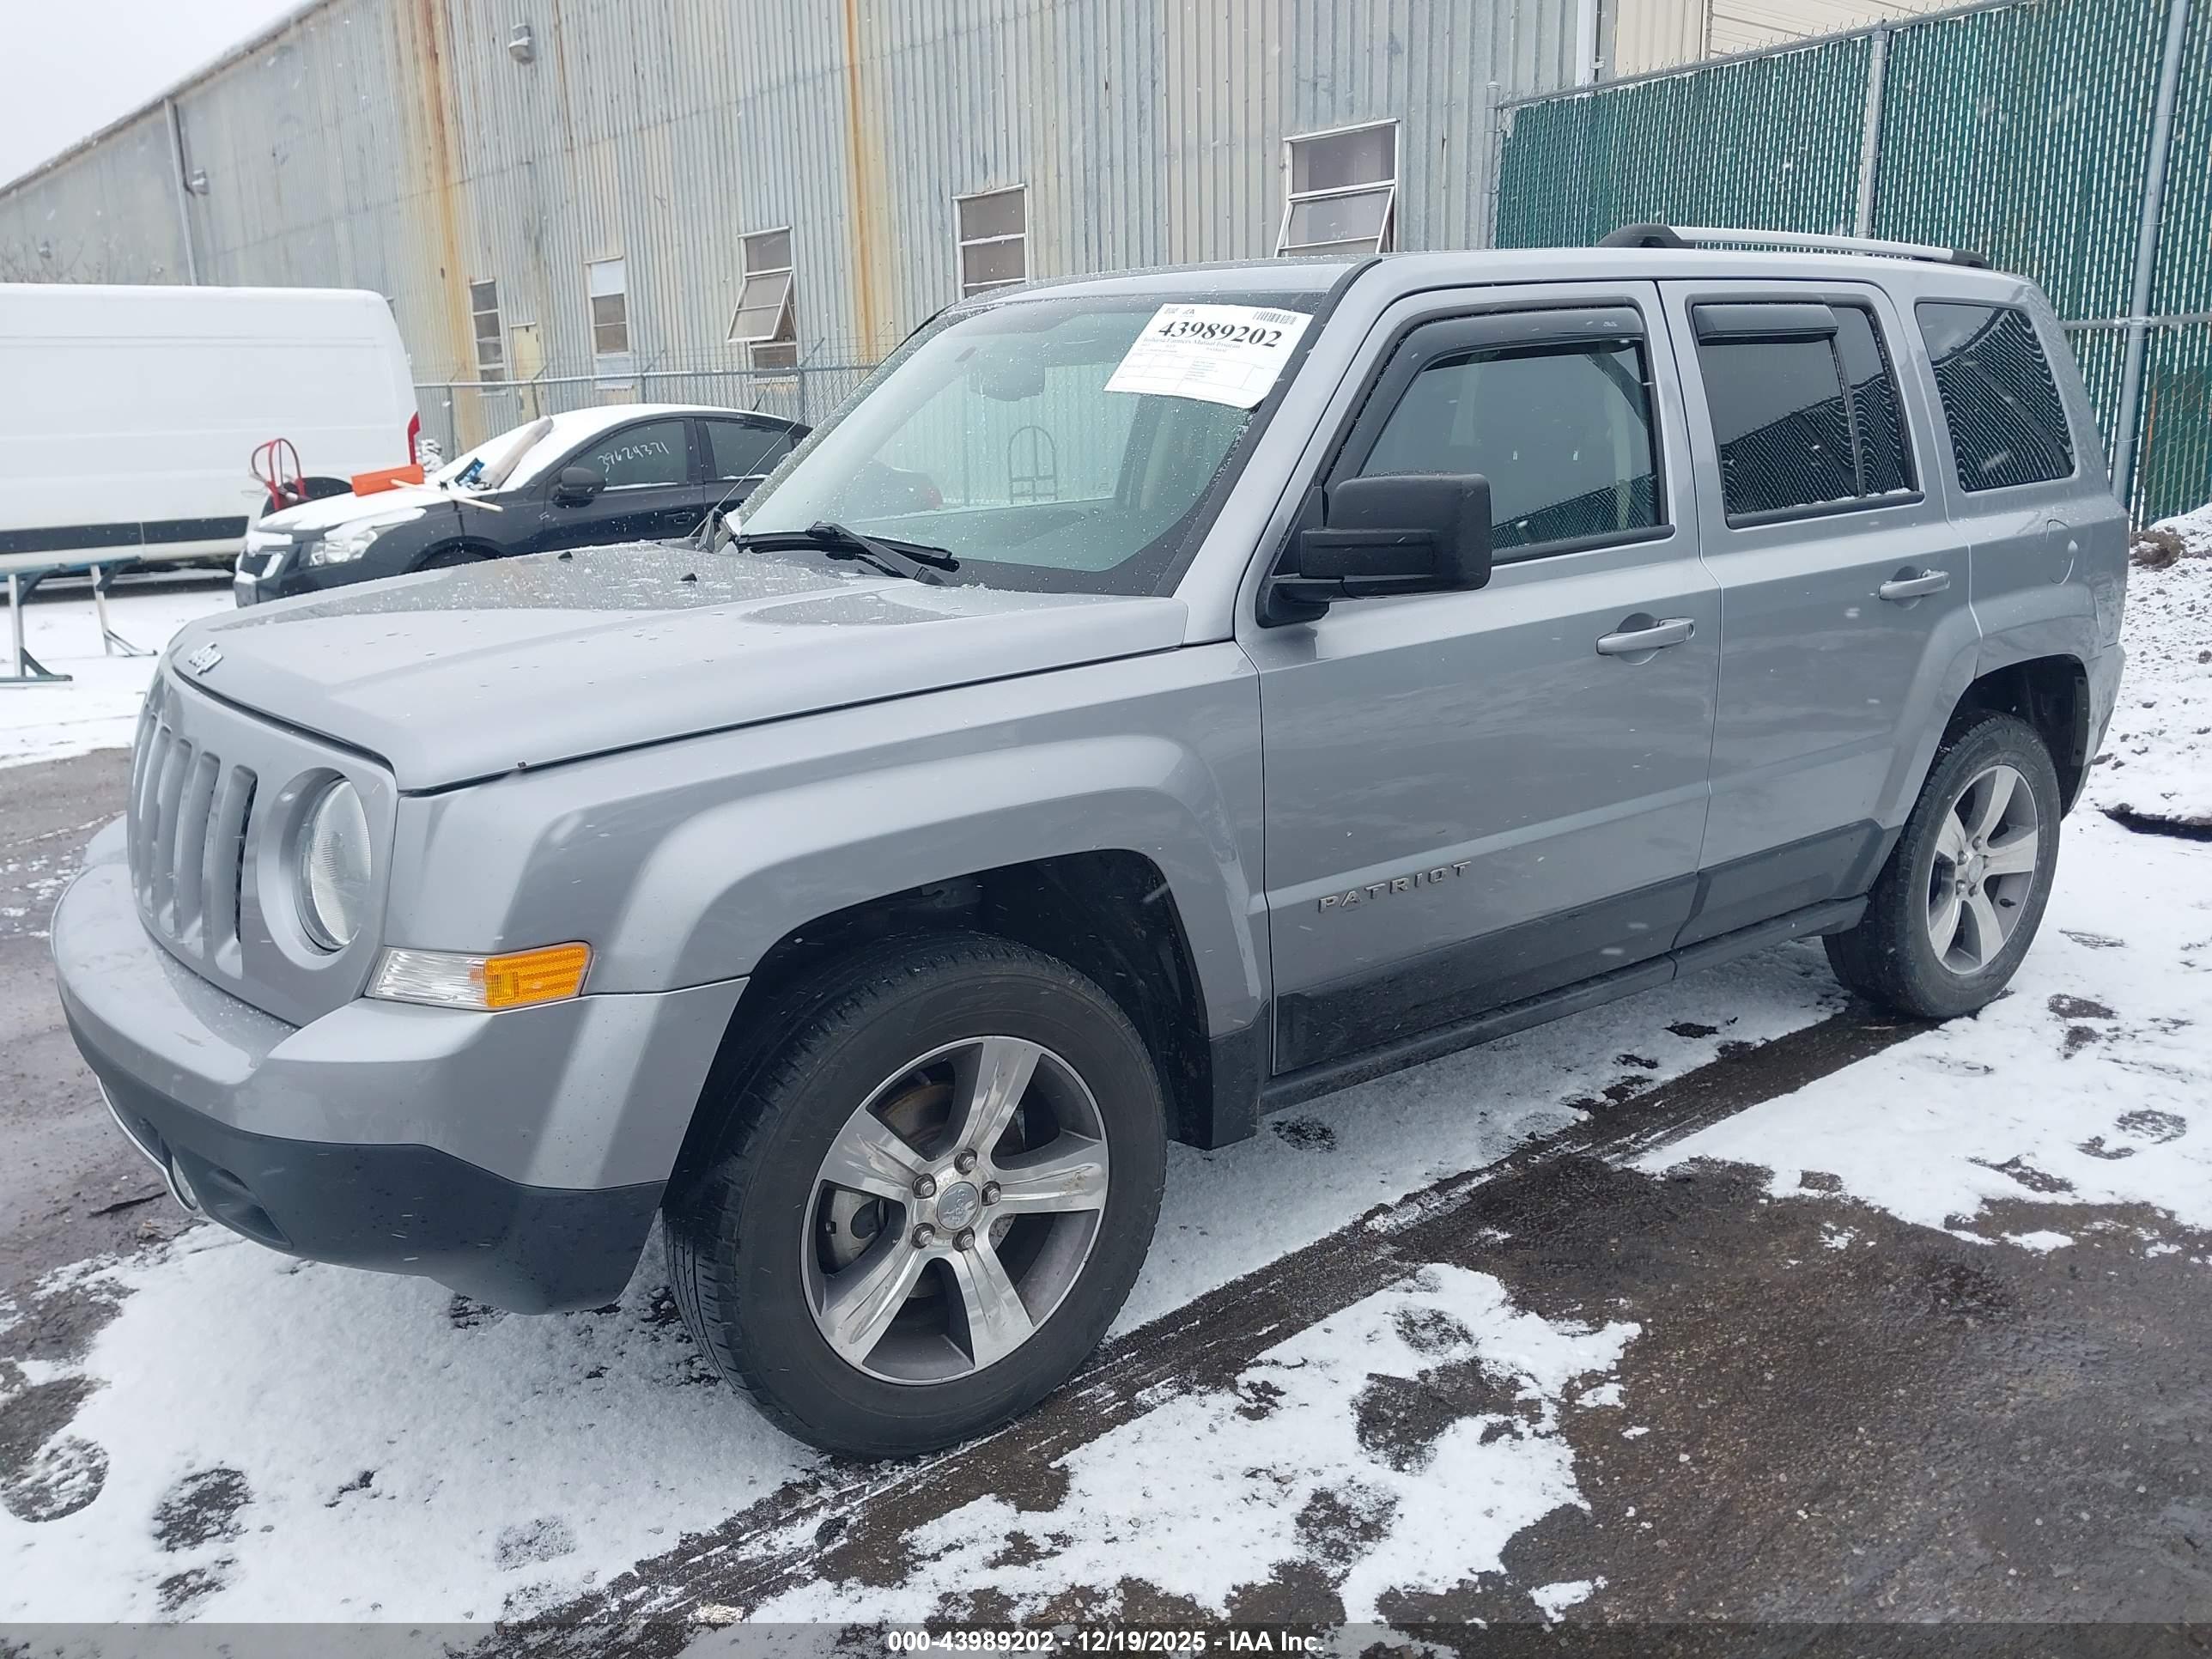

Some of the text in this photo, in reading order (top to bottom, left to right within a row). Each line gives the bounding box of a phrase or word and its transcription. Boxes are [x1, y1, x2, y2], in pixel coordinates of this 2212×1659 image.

[1158, 320, 1283, 348] 43989202
[597, 441, 670, 473] 39624371
[1317, 860, 1473, 914] PATRIOT
